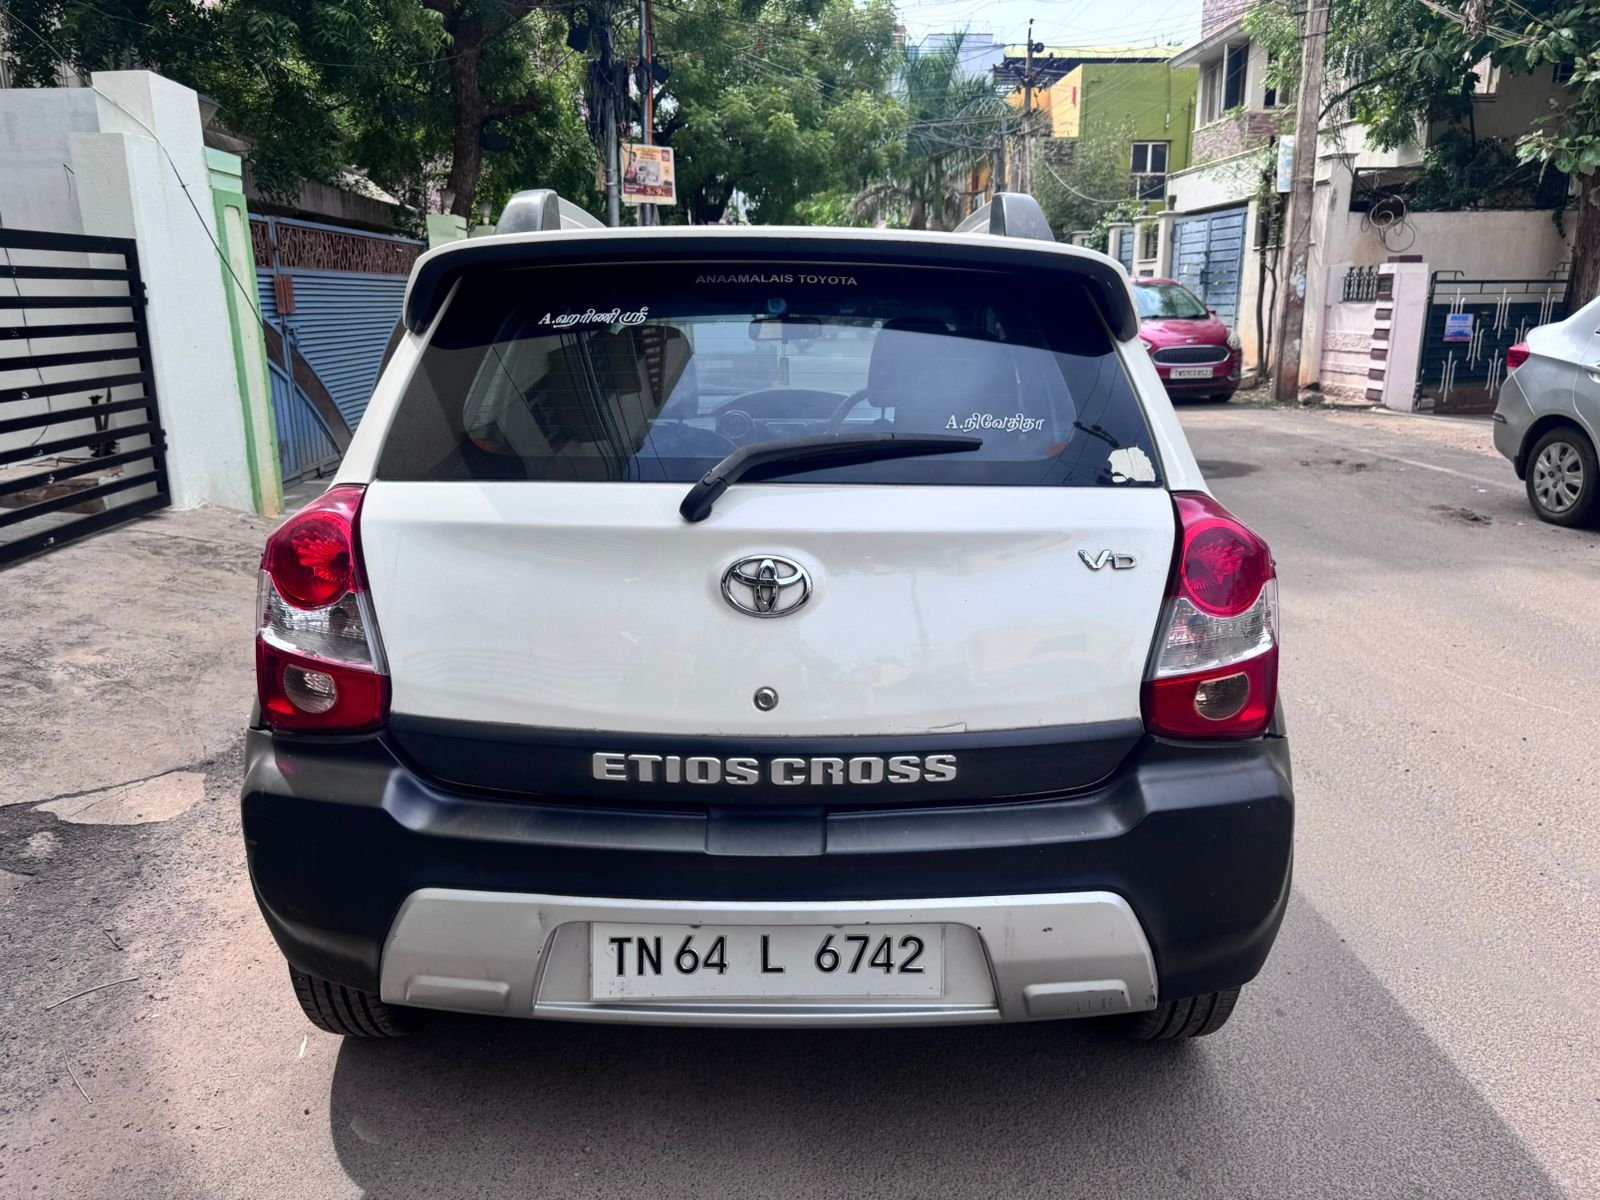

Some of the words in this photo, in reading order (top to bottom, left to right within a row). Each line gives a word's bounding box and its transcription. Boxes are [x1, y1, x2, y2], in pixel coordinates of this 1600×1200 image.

[695, 274, 794, 284] ANAAMALAIS
[798, 274, 858, 286] TOYOTA
[1078, 549, 1137, 571] VD
[592, 752, 759, 785] ETIOS
[770, 754, 957, 786] CROSS
[760, 934, 785, 974] L
[815, 933, 926, 974] 6742
